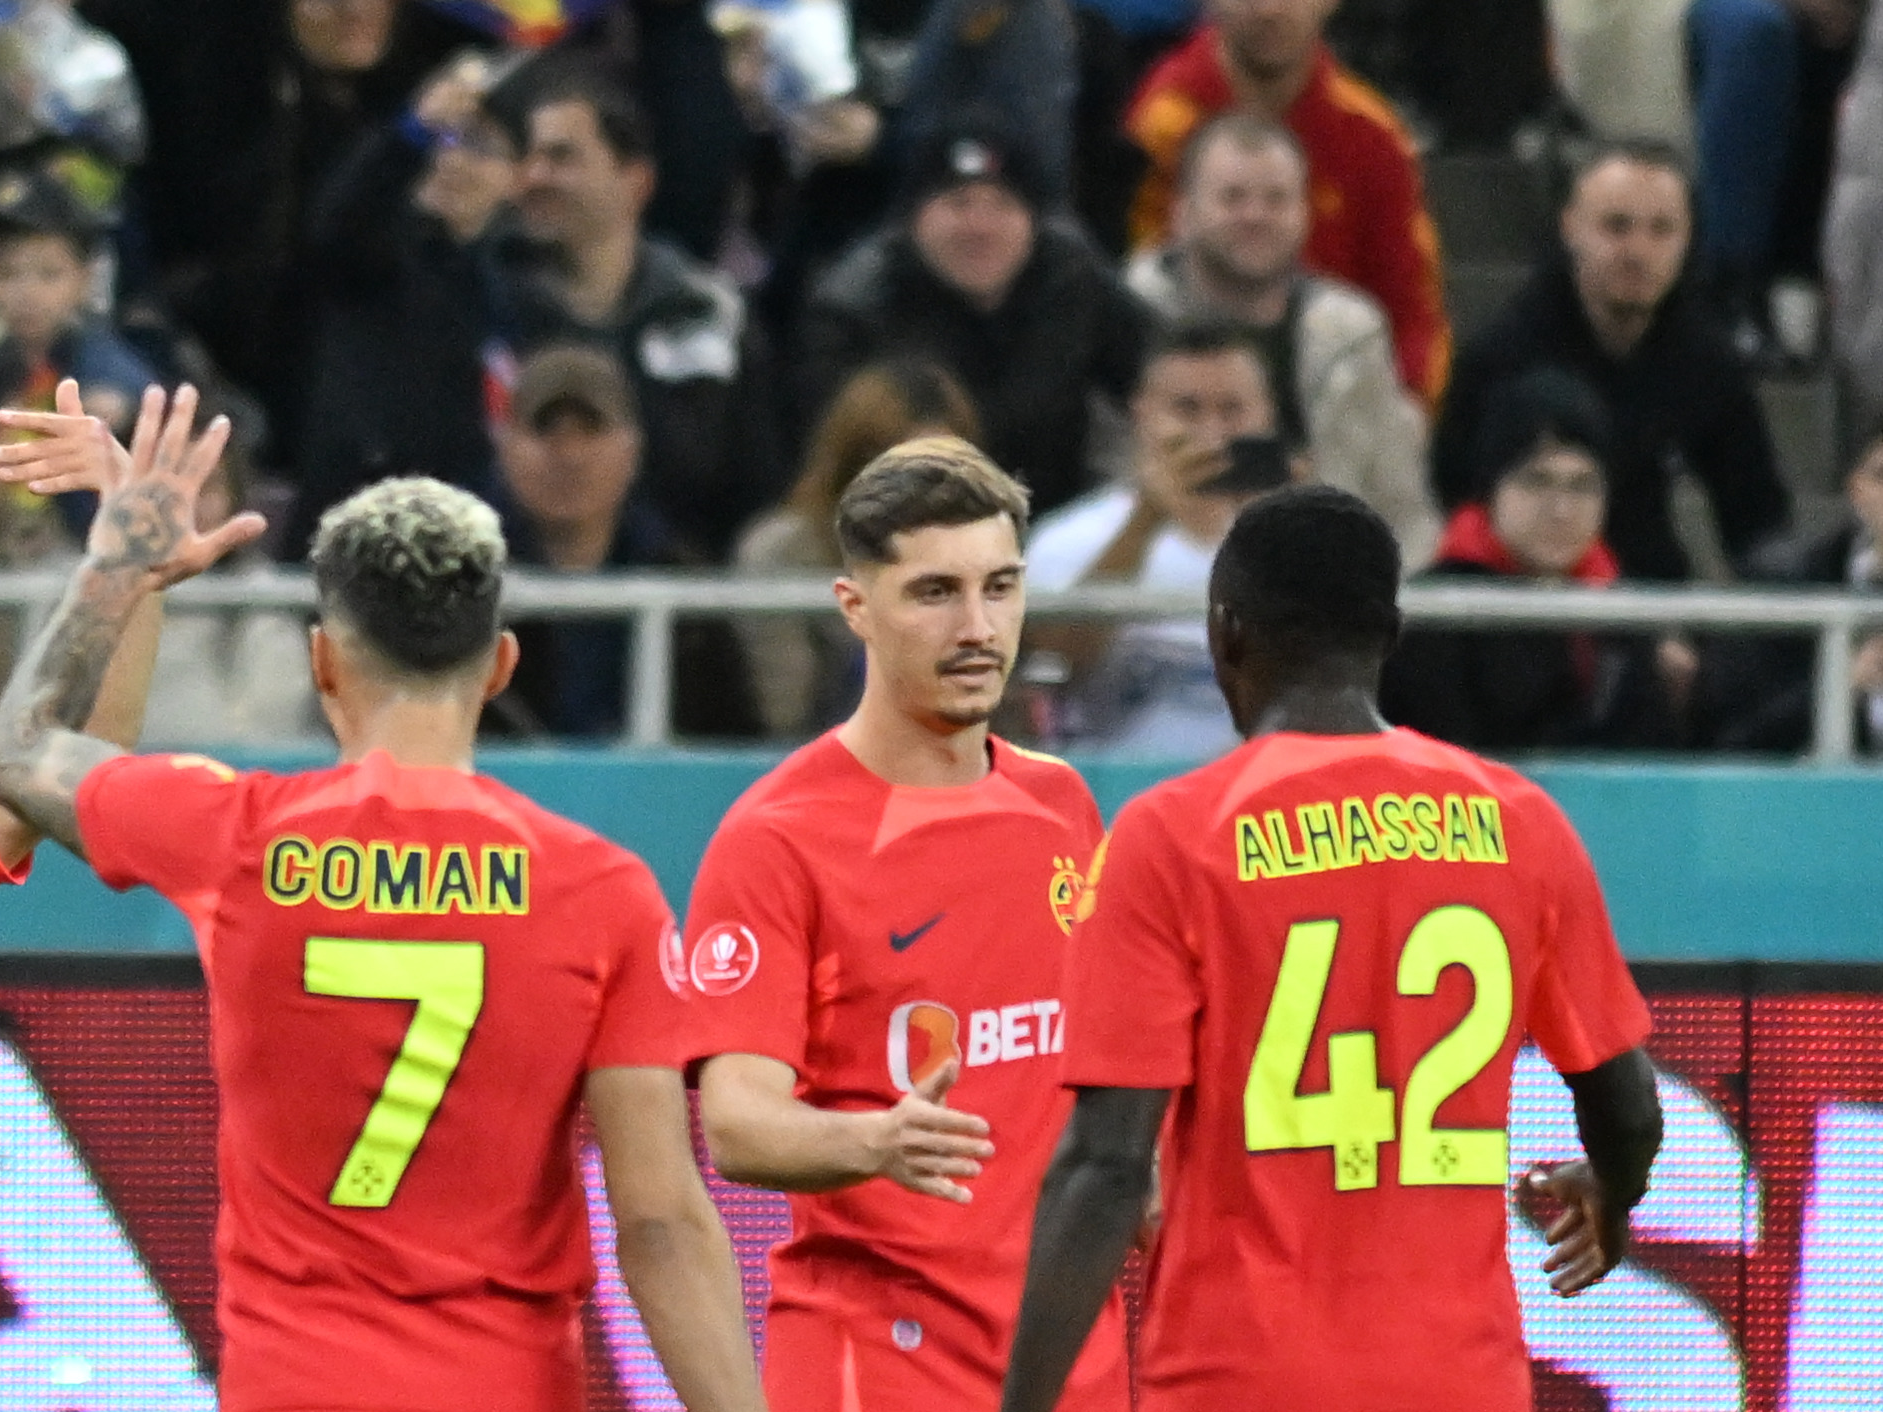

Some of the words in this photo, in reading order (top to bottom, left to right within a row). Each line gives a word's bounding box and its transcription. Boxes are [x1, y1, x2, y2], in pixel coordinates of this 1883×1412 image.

[263, 833, 529, 914] COMAN
[1235, 792, 1509, 881] ALHASSAN
[304, 937, 485, 1207] 7
[1243, 905, 1513, 1191] 42
